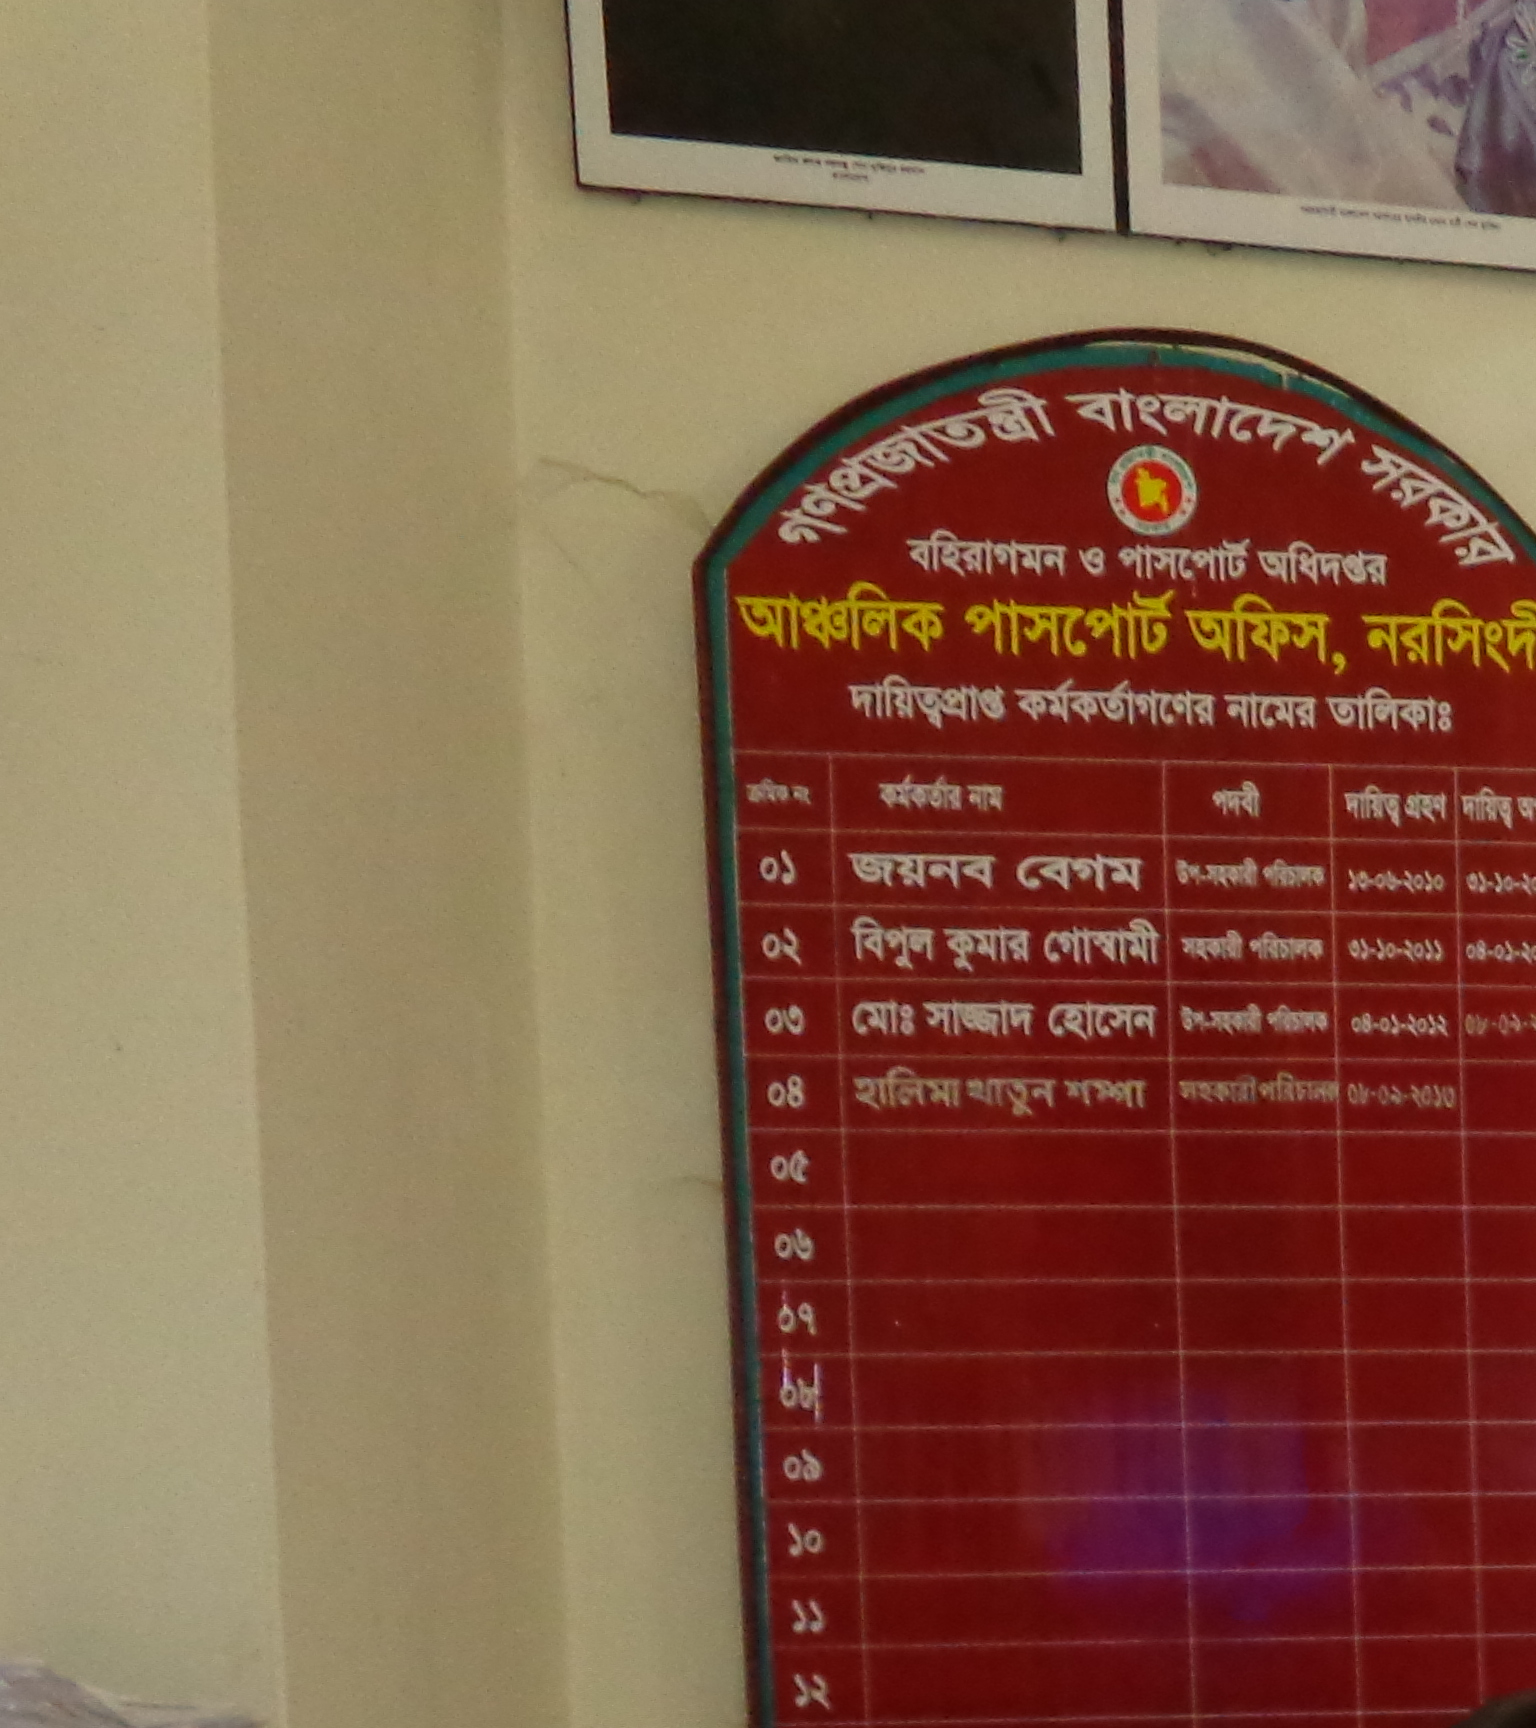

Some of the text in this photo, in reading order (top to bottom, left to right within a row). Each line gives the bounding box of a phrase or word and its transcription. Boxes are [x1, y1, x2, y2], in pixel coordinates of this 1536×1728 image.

[778, 388, 1055, 544] গণপ্রজাতন্ত্রী
[1064, 388, 1355, 466] বাংলাদেশ
[1361, 444, 1516, 567] সরকার
[907, 529, 1388, 586] বহিরাগমন ও পাসপোর্ট অধিদপ্তর
[735, 581, 944, 652] আঞ্চলিক
[964, 590, 1175, 659] পাসপোর্ট
[1186, 593, 1348, 675] অফিস,
[1015, 678, 1214, 727] কর্মকর্তাগণের
[1224, 688, 1315, 729] নামের
[966, 783, 1004, 811] নাম
[760, 850, 796, 885] ০১
[847, 851, 995, 890] জয়নব
[1016, 855, 1143, 892] বেগম
[762, 928, 801, 965] ০২
[851, 915, 934, 970] বিপুল
[943, 926, 1031, 973] কুমার
[765, 1003, 806, 1035] ০৩
[852, 1000, 915, 1036] মোঃ
[922, 999, 1034, 1038] সাজ্জাদ
[1047, 1001, 1157, 1041] হোসেন
[767, 1073, 806, 1108] ০৪
[852, 1065, 960, 1110] হালিমা
[773, 1227, 816, 1262] ০৬
[776, 1302, 818, 1336] ০৭
[787, 1522, 826, 1558] ১০
[791, 1599, 826, 1634] ১১
[793, 1673, 831, 1710] ১২
